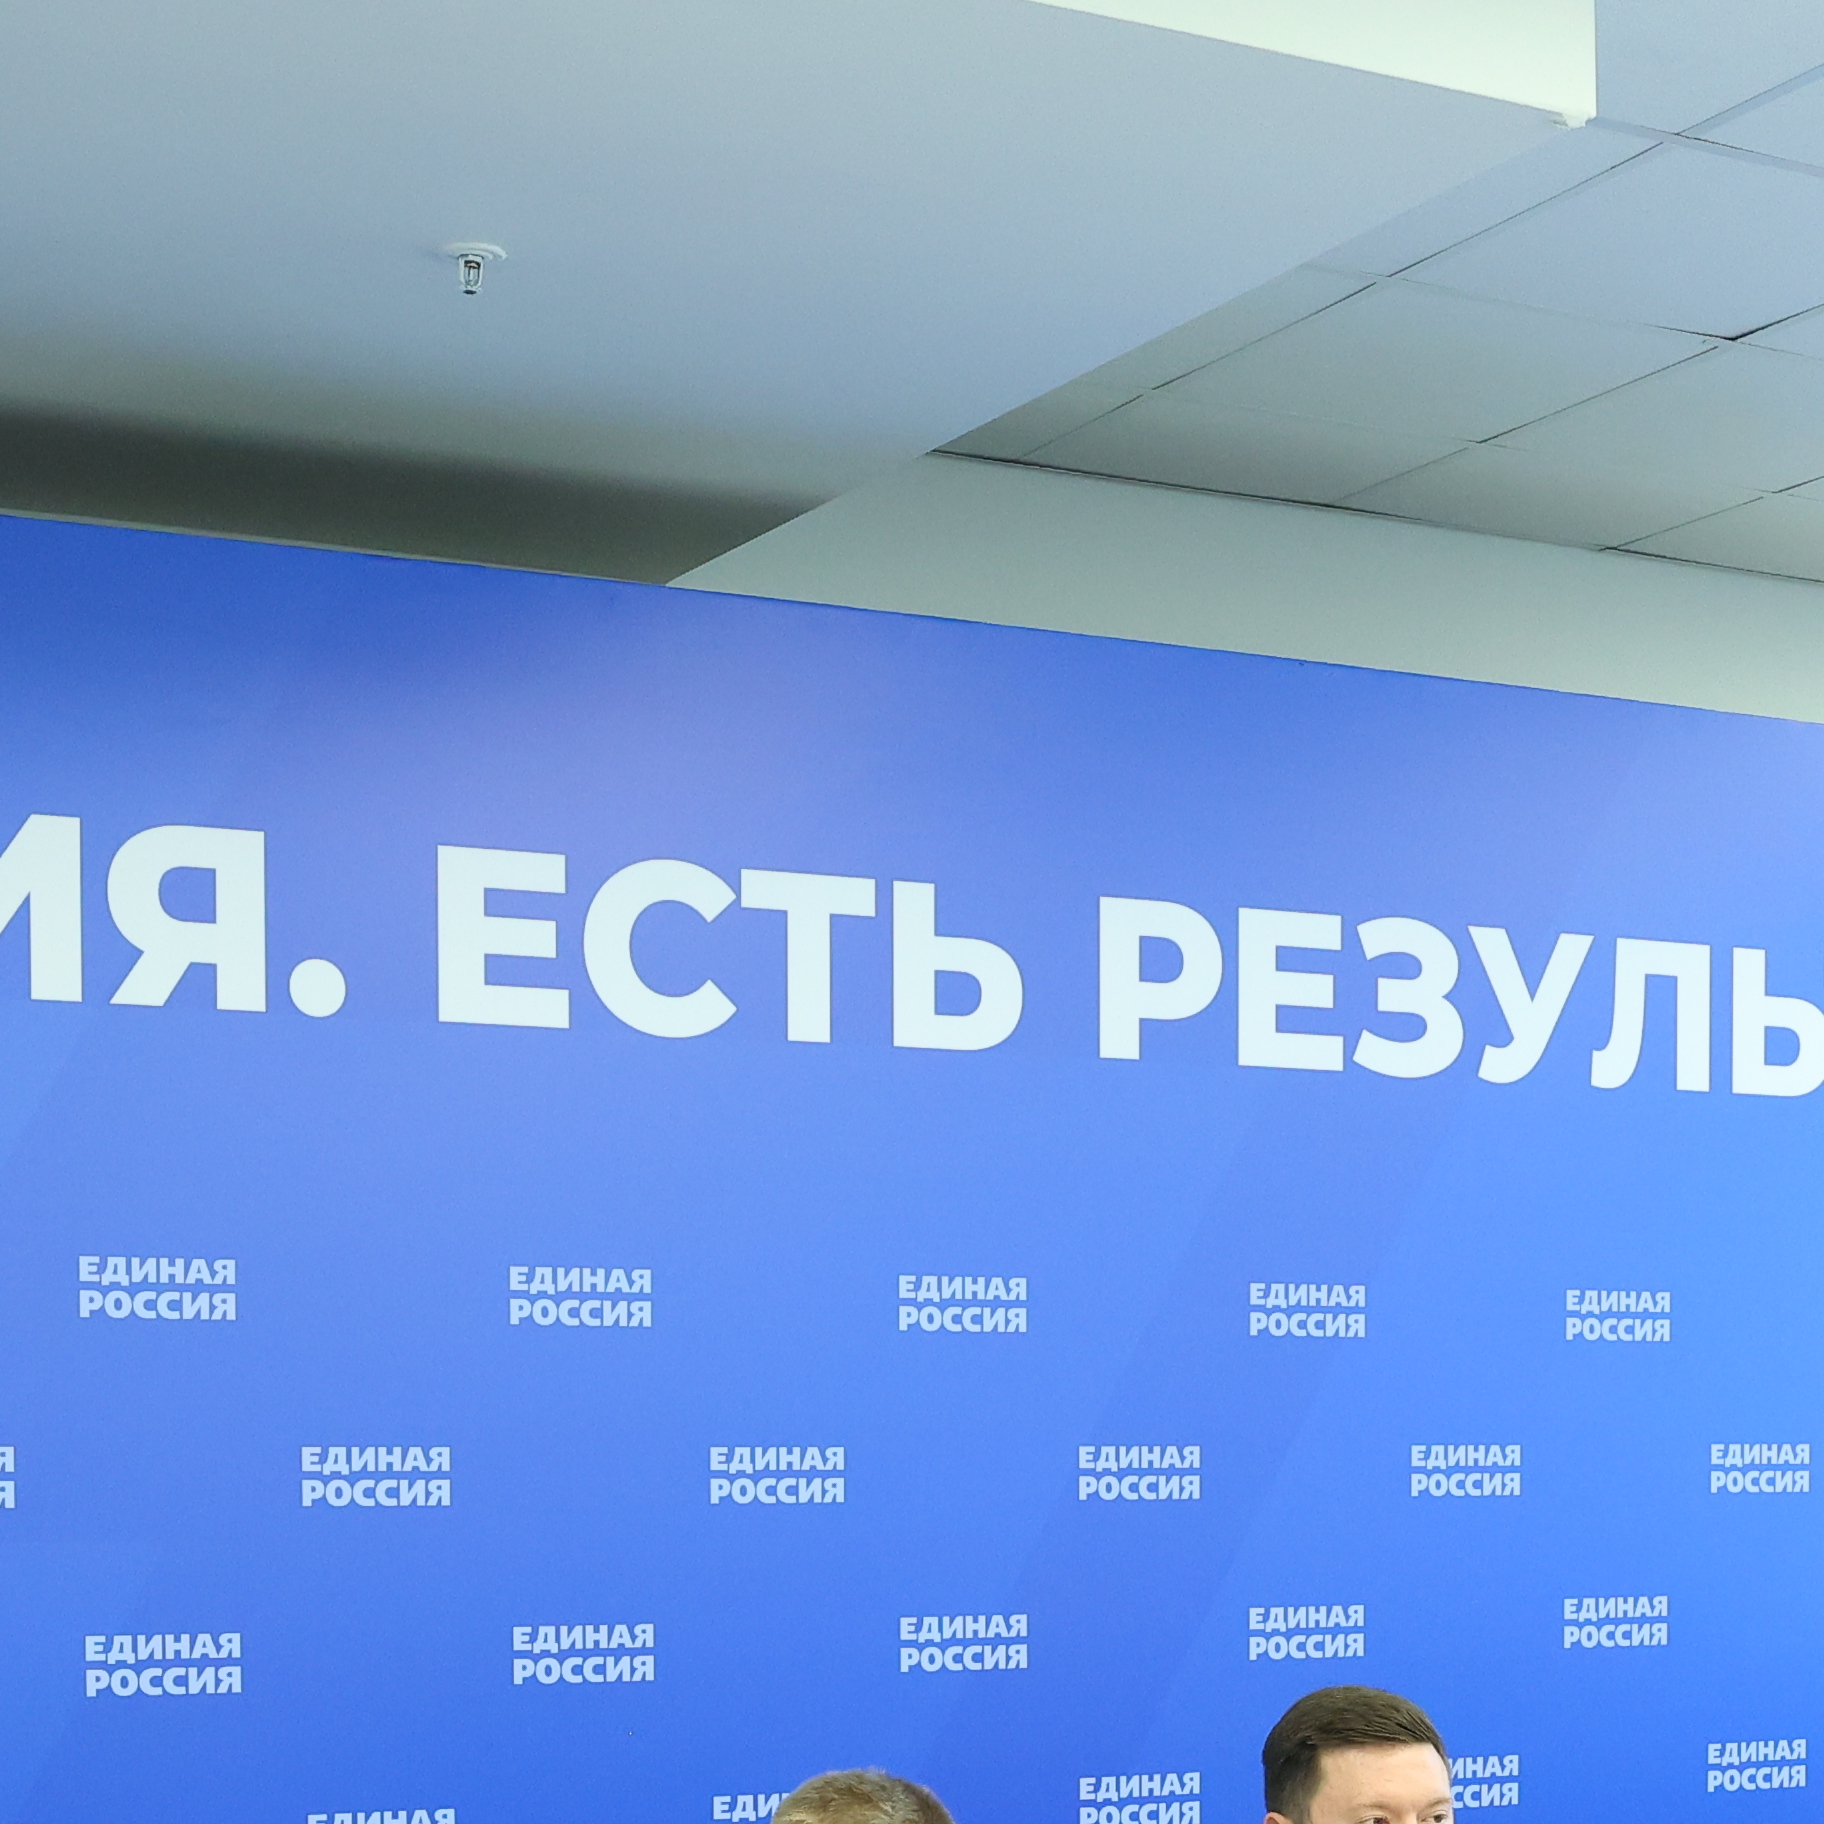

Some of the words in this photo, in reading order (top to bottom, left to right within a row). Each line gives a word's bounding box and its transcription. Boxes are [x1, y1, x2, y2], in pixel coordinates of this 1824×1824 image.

[438, 846, 1022, 1050] ЕСТЬ
[79, 1256, 235, 1286] ЕДИНАЯ
[510, 1266, 651, 1294] ЕДИНАЯ
[899, 1275, 1027, 1302] ЕДИНАЯ
[1250, 1283, 1365, 1308] ЕДИНАЯ
[1566, 1290, 1670, 1314] ЕДИНАЯ
[80, 1290, 236, 1320] РОССИЯ
[510, 1299, 651, 1327] РОССИЯ
[899, 1306, 1026, 1332] РОССИЯ
[1250, 1312, 1365, 1337] РОССИЯ
[1566, 1317, 1670, 1341] РОССИЯ
[302, 1447, 450, 1475] ЕДИНАЯ
[710, 1447, 844, 1474] ЕДИНАЯ
[1079, 1446, 1200, 1472] ЕДИНАЯ
[1411, 1445, 1520, 1470] ЕДИНАЯ
[1711, 1444, 1810, 1467] ЕДИНАЯ
[302, 1479, 450, 1506] РОССИЯ
[710, 1478, 844, 1504] РОССИЯ
[1079, 1475, 1200, 1500] РОССИЯ
[1411, 1473, 1520, 1496] РОССИЯ
[1711, 1471, 1809, 1493] РОССИЯ
[1249, 1605, 1364, 1632] ЕДИНАЯ
[1564, 1596, 1668, 1622] ЕДИНАЯ
[513, 1624, 654, 1654] ЕДИНАЯ
[900, 1614, 1027, 1643] ЕДИНАЯ
[1564, 1623, 1667, 1648] РОССИЯ
[85, 1633, 241, 1664] ЕДИНАЯ
[900, 1644, 1027, 1672] РОССИЯ
[1249, 1633, 1364, 1660] РОССИЯ
[86, 1666, 242, 1697] РОССИЯ
[513, 1655, 654, 1684] РОССИЯ
[1708, 1739, 1806, 1766] ЕДИНАЯ
[1449, 1755, 1519, 1779] ИНАЯ
[1708, 1765, 1806, 1792] РОССИЯ
[1079, 1772, 1200, 1802] ЕДИНАЯ
[1452, 1782, 1519, 1809] ССИЯ
